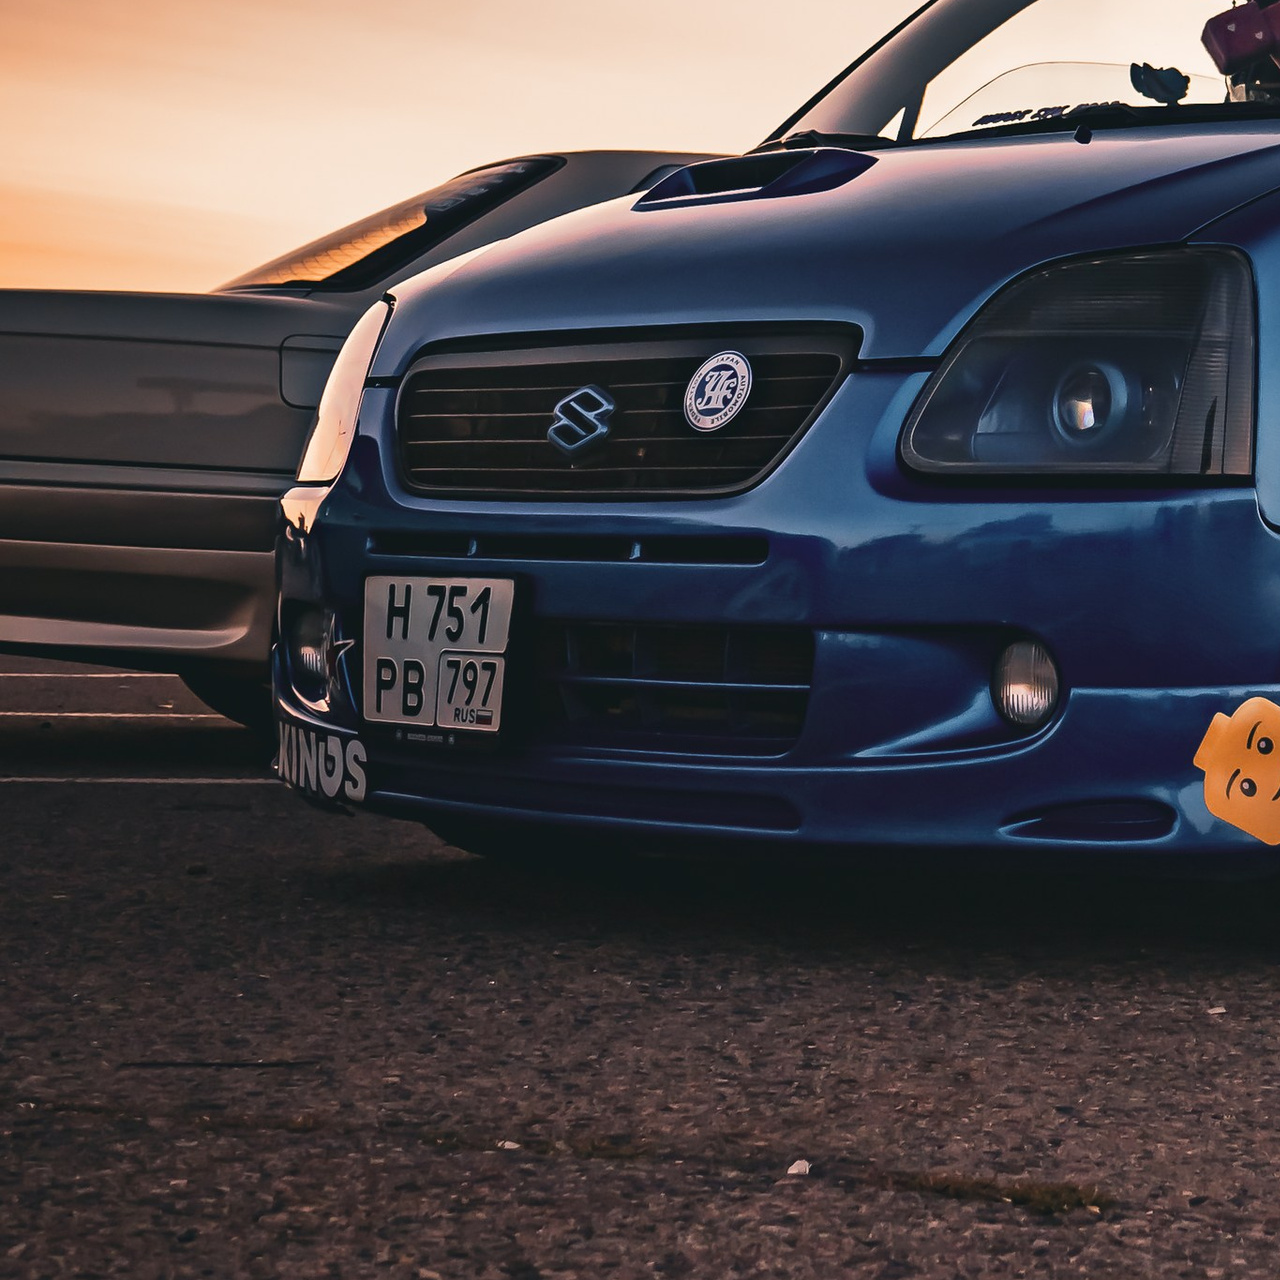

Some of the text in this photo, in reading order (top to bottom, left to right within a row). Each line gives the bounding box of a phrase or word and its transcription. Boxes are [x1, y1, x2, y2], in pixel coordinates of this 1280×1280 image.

[716, 356, 740, 366] JAPAN
[386, 583, 492, 644] H 751
[376, 658, 498, 717] PB 797
[454, 707, 476, 724] RUS
